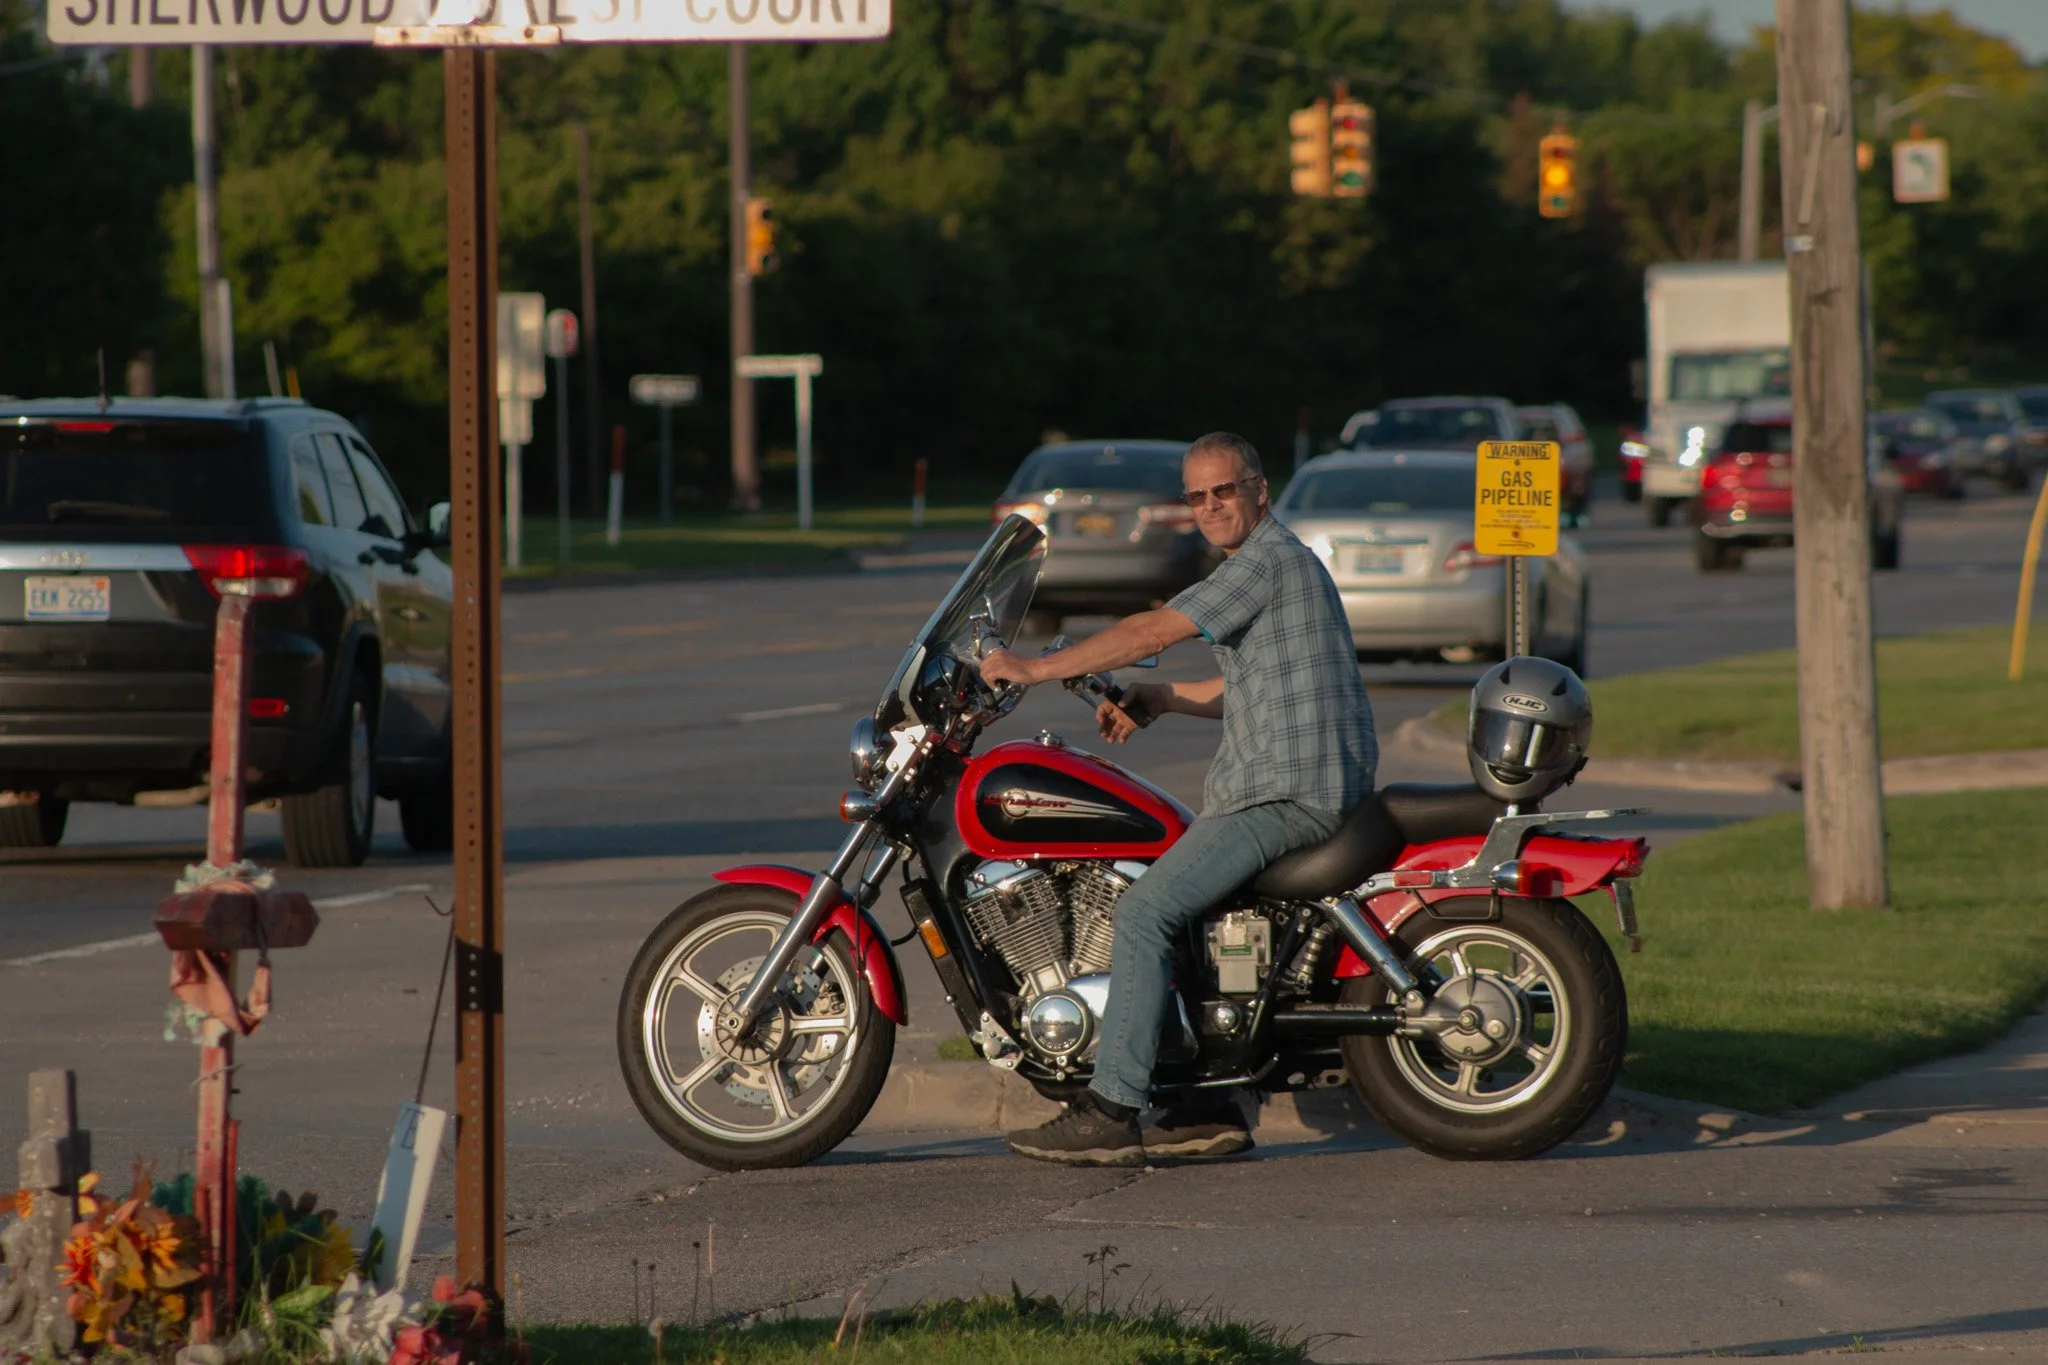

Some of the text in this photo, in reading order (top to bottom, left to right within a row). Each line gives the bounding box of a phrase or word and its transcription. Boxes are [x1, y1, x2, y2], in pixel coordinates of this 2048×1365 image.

[1490, 444, 1547, 458] WARNING
[1501, 470, 1533, 487] GAS
[1480, 489, 1552, 506] PIPELINE
[1509, 697, 1541, 709] HJC
